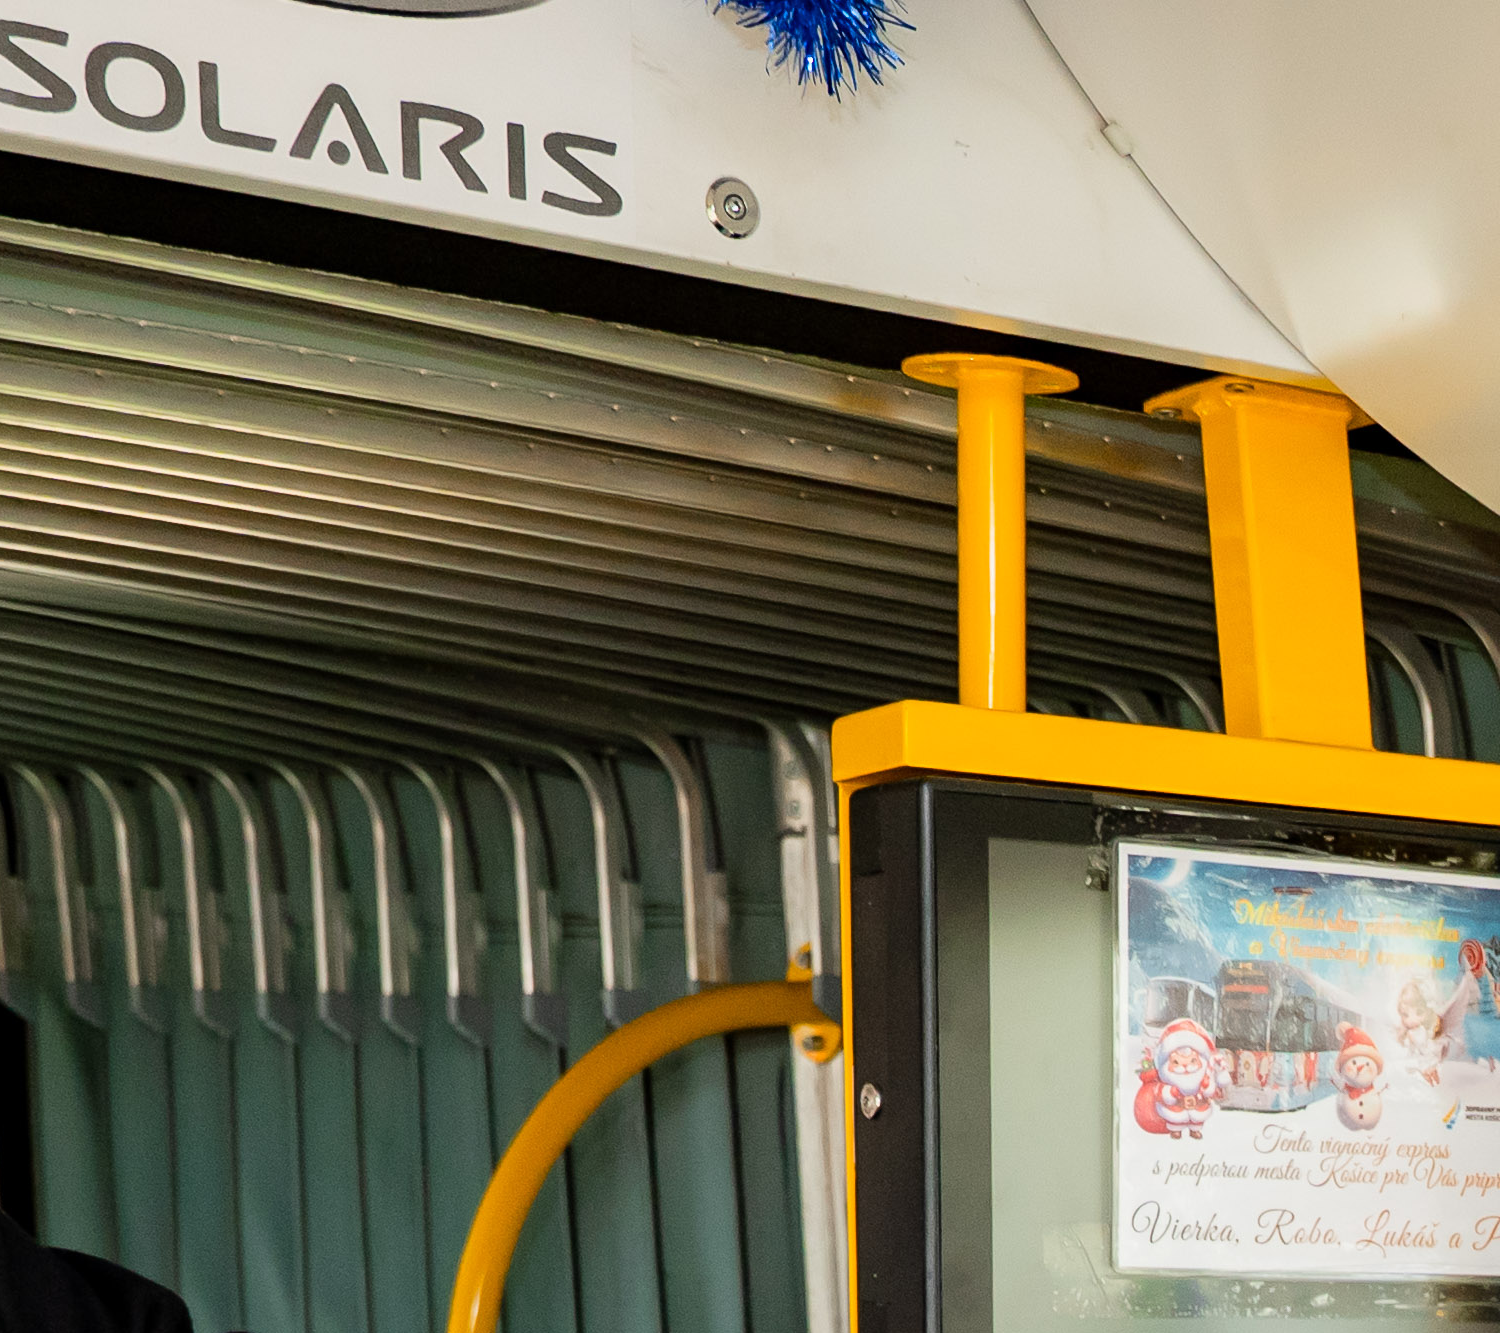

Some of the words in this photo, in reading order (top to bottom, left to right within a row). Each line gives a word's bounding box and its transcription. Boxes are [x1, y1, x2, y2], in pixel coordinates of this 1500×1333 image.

[1253, 1123, 1312, 1155] Tento
[1319, 1135, 1390, 1167] vianočný
[1396, 1142, 1451, 1168] express
[1152, 1160, 1160, 1175] s
[1164, 1153, 1249, 1188] podporou
[1254, 1158, 1301, 1181] mesta
[1307, 1155, 1379, 1190] Košice
[1380, 1168, 1409, 1194] pre
[1413, 1157, 1458, 1190] Vás
[1131, 1200, 1240, 1245] Vierka,
[1355, 1208, 1440, 1259] Lukáš
[1448, 1231, 1462, 1249] a
